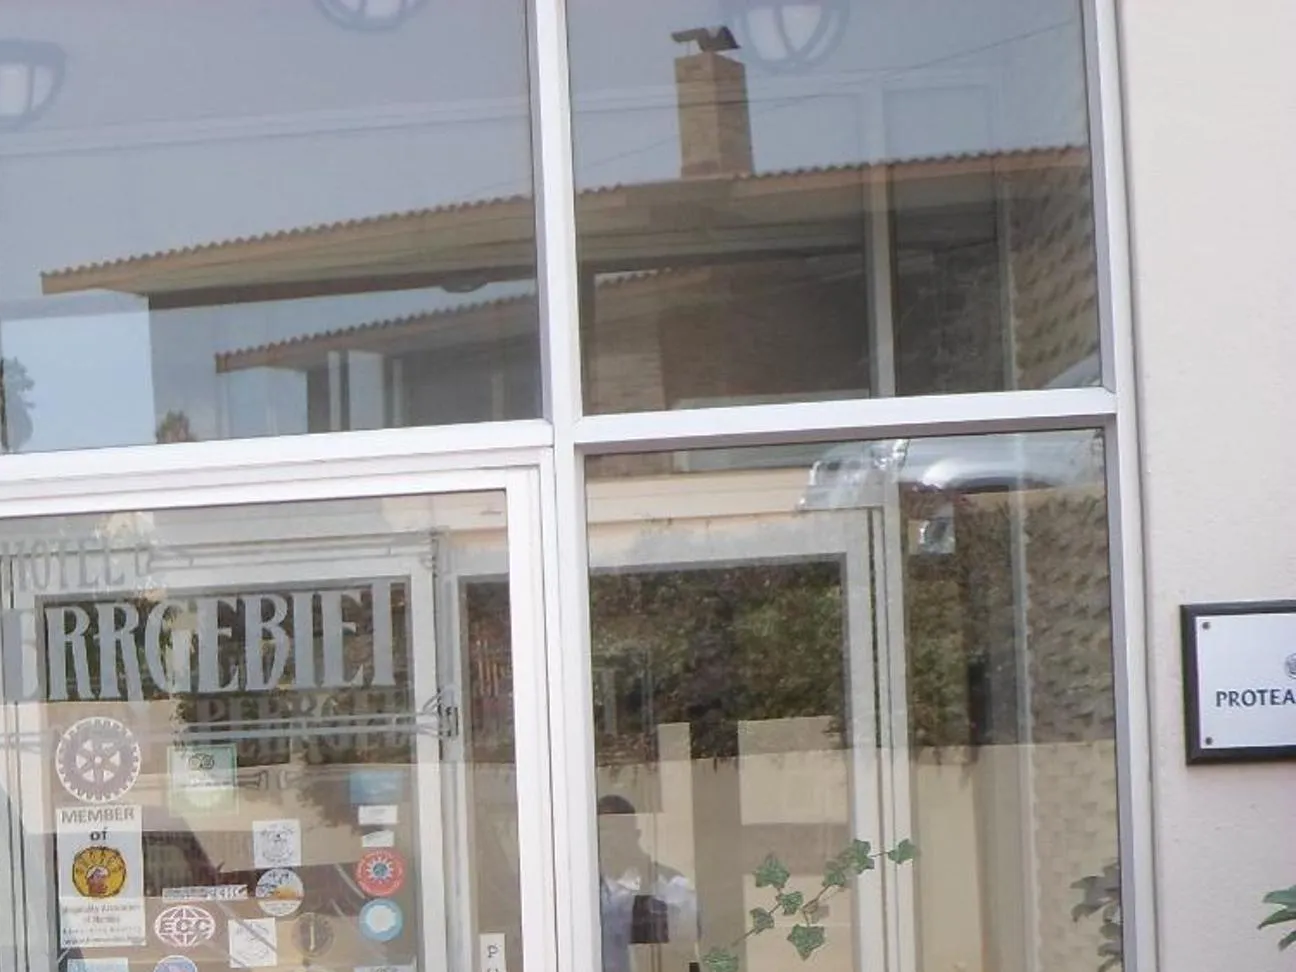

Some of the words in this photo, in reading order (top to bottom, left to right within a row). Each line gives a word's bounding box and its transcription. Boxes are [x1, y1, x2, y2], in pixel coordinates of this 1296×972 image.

[1215, 688, 1296, 707] PROTEA
[61, 807, 135, 824] MEMBER
[89, 826, 108, 841] of
